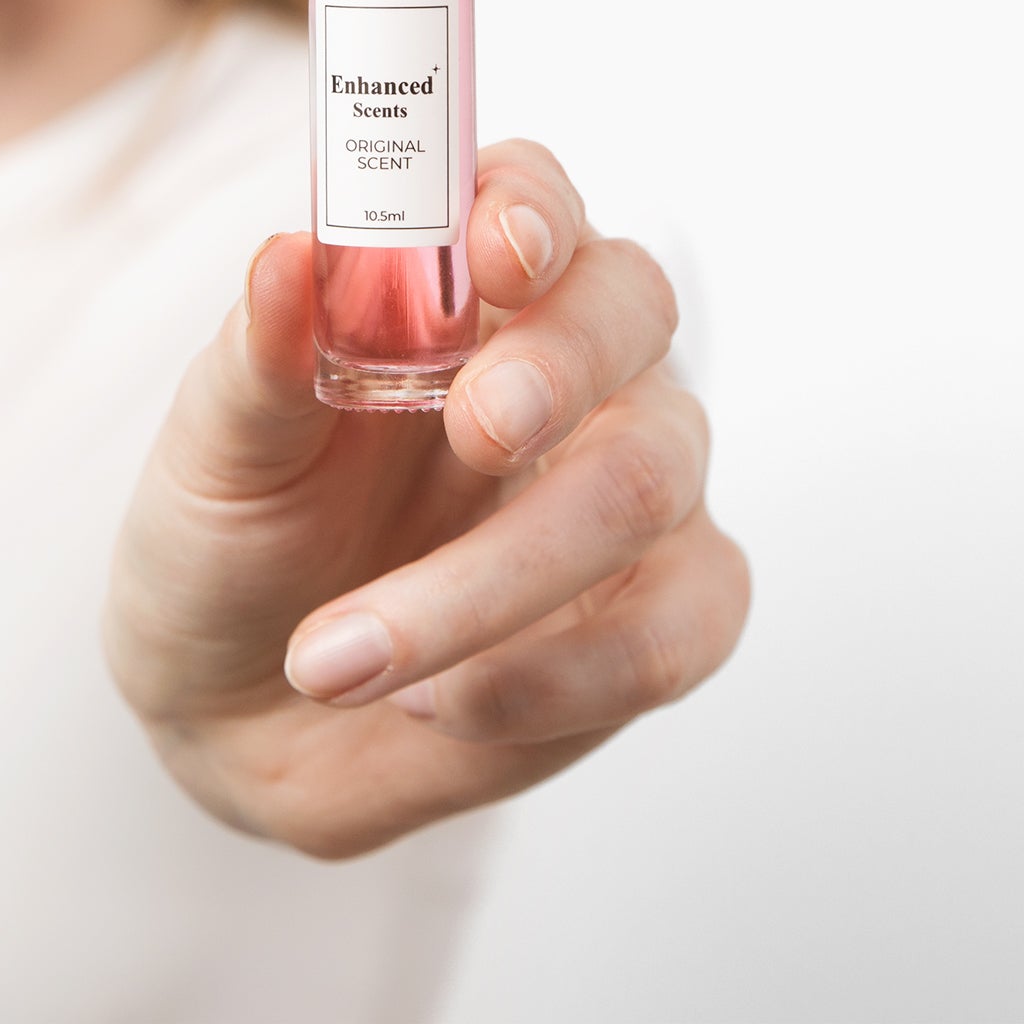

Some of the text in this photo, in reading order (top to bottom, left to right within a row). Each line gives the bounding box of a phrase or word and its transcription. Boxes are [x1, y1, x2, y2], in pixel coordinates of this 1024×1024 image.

[331, 75, 434, 95] Enhanced
[352, 102, 408, 119] Scents
[345, 139, 426, 153] ORIGINAL
[357, 157, 413, 170] SCENT
[364, 210, 405, 222] 10.5ml
